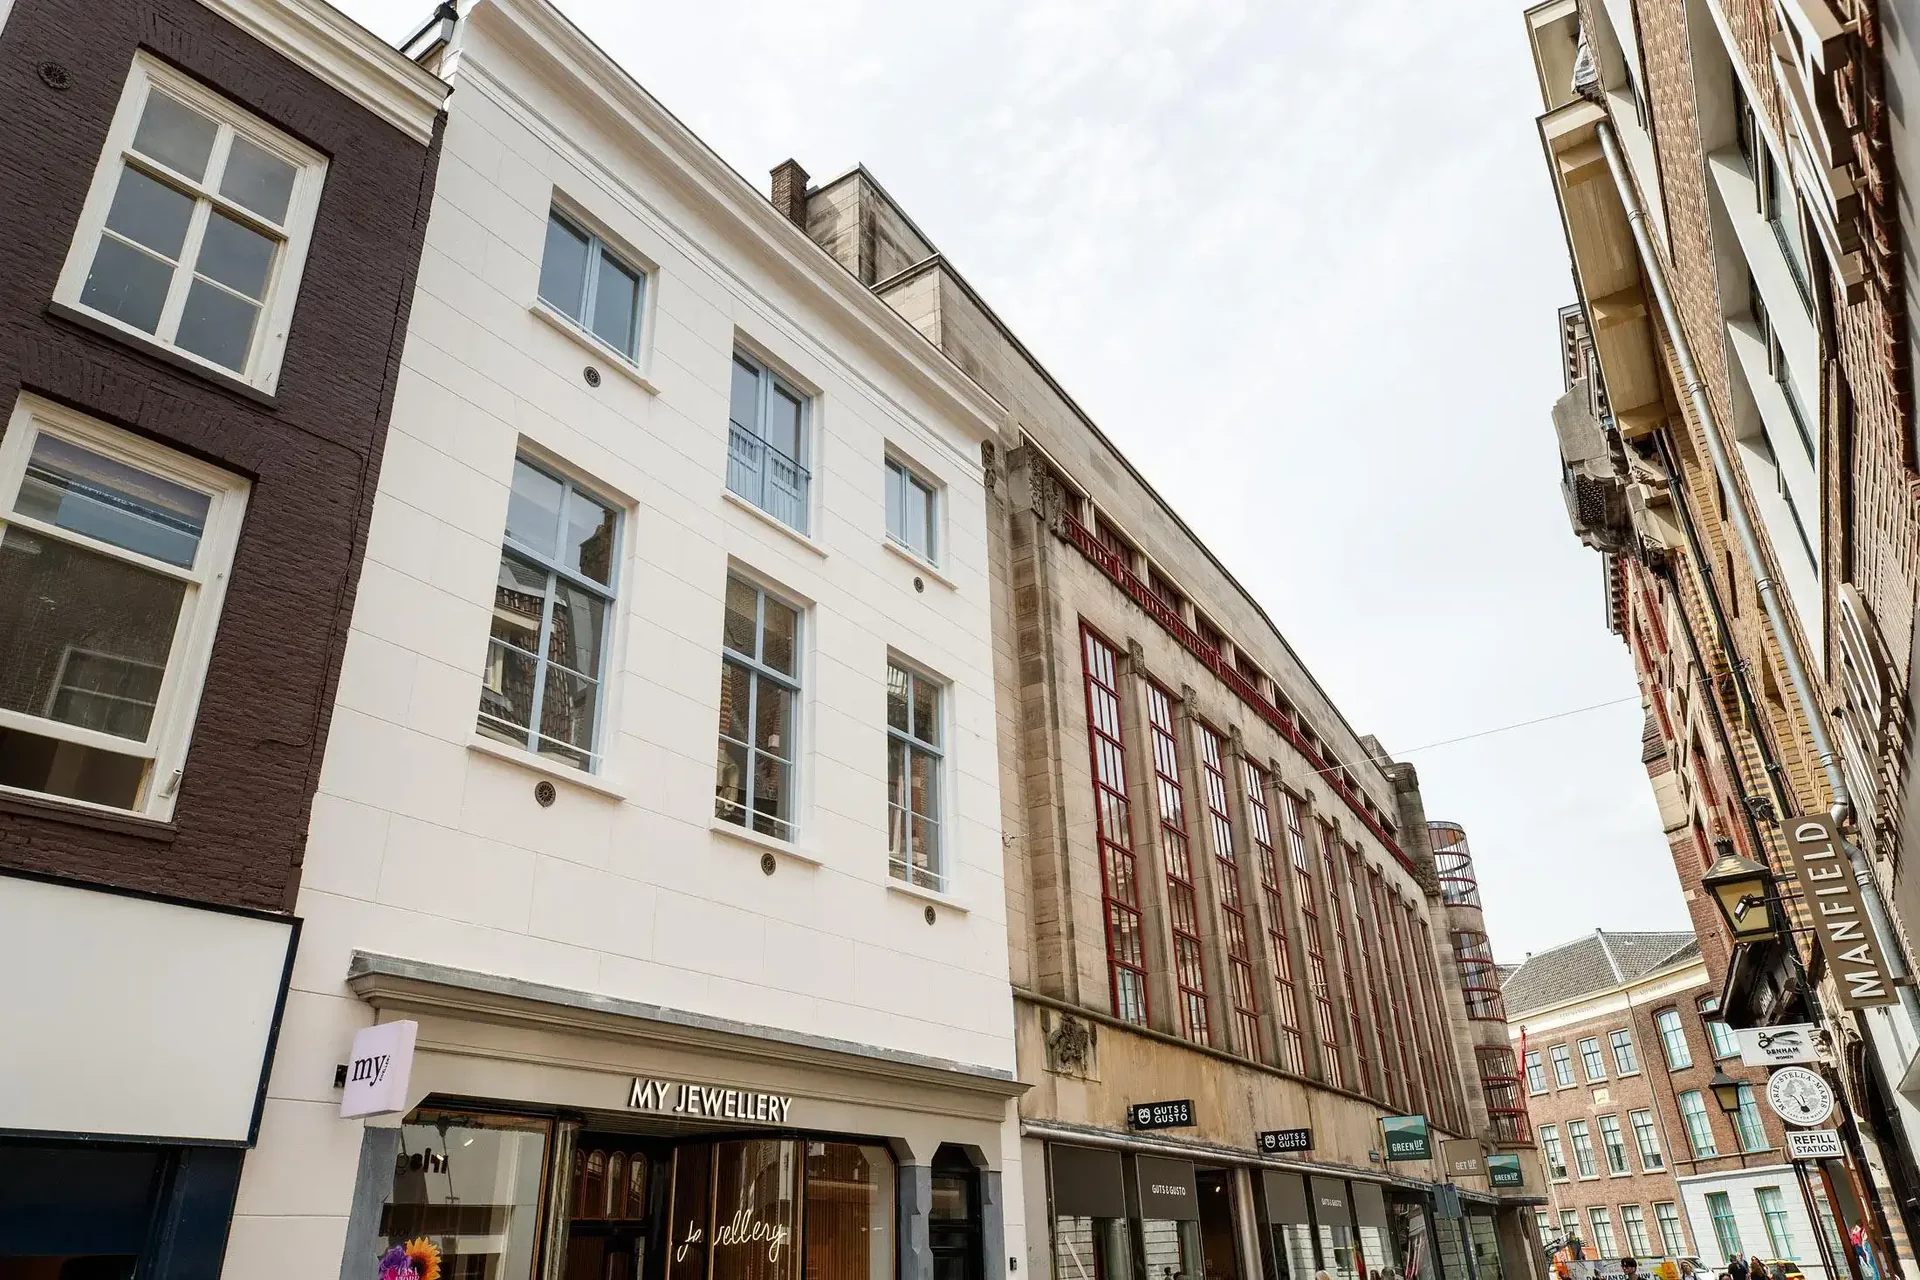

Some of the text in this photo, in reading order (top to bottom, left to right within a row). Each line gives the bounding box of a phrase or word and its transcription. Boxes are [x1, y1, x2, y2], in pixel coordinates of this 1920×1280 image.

[1795, 822, 1887, 998] MANFIELD
[1766, 1047, 1800, 1056] DENHAM
[352, 1054, 387, 1087] my
[628, 1077, 793, 1123] MY JEWELLERY
[1153, 1105, 1179, 1115] GUTS
[1154, 1113, 1188, 1124] GUSTO
[1277, 1132, 1299, 1141] GUTS
[1794, 1133, 1835, 1145] REFILL
[1278, 1139, 1307, 1148] GUSTO
[1391, 1139, 1424, 1152] GREEN UP
[1796, 1144, 1837, 1154] STATION
[1455, 1159, 1477, 1171] GET UP
[1510, 1172, 1518, 1181] UP
